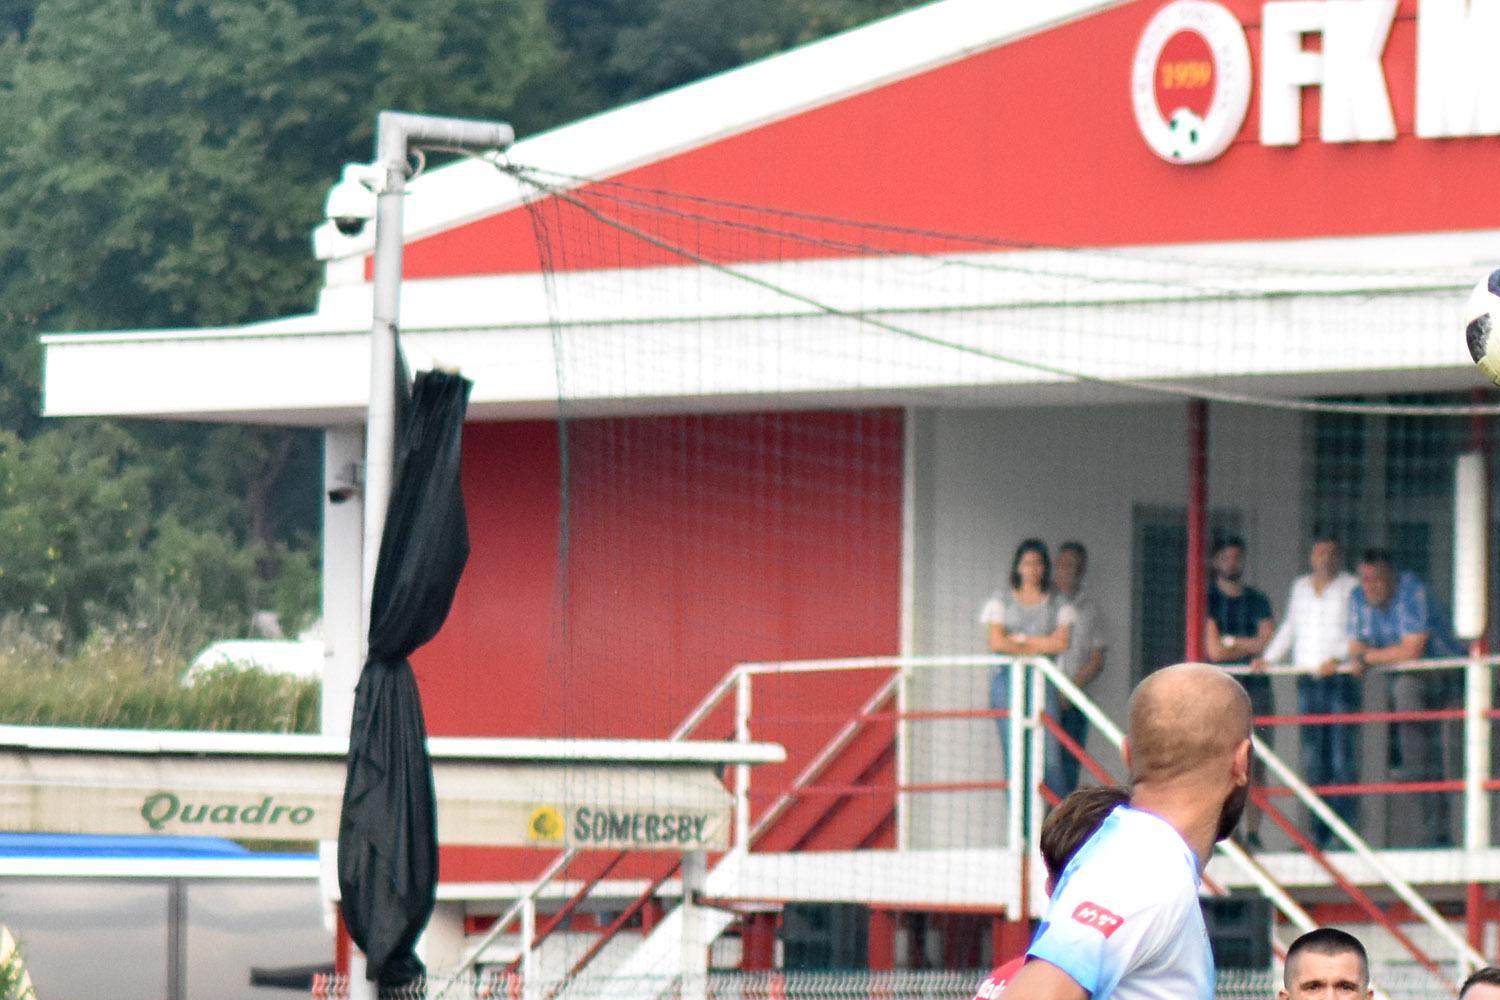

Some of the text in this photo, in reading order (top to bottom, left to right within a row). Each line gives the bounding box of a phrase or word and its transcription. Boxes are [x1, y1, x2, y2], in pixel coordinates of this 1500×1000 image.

[1259, 0, 1398, 146] FK
[141, 791, 315, 830] Quadro
[574, 806, 708, 844] SOMERSBY
